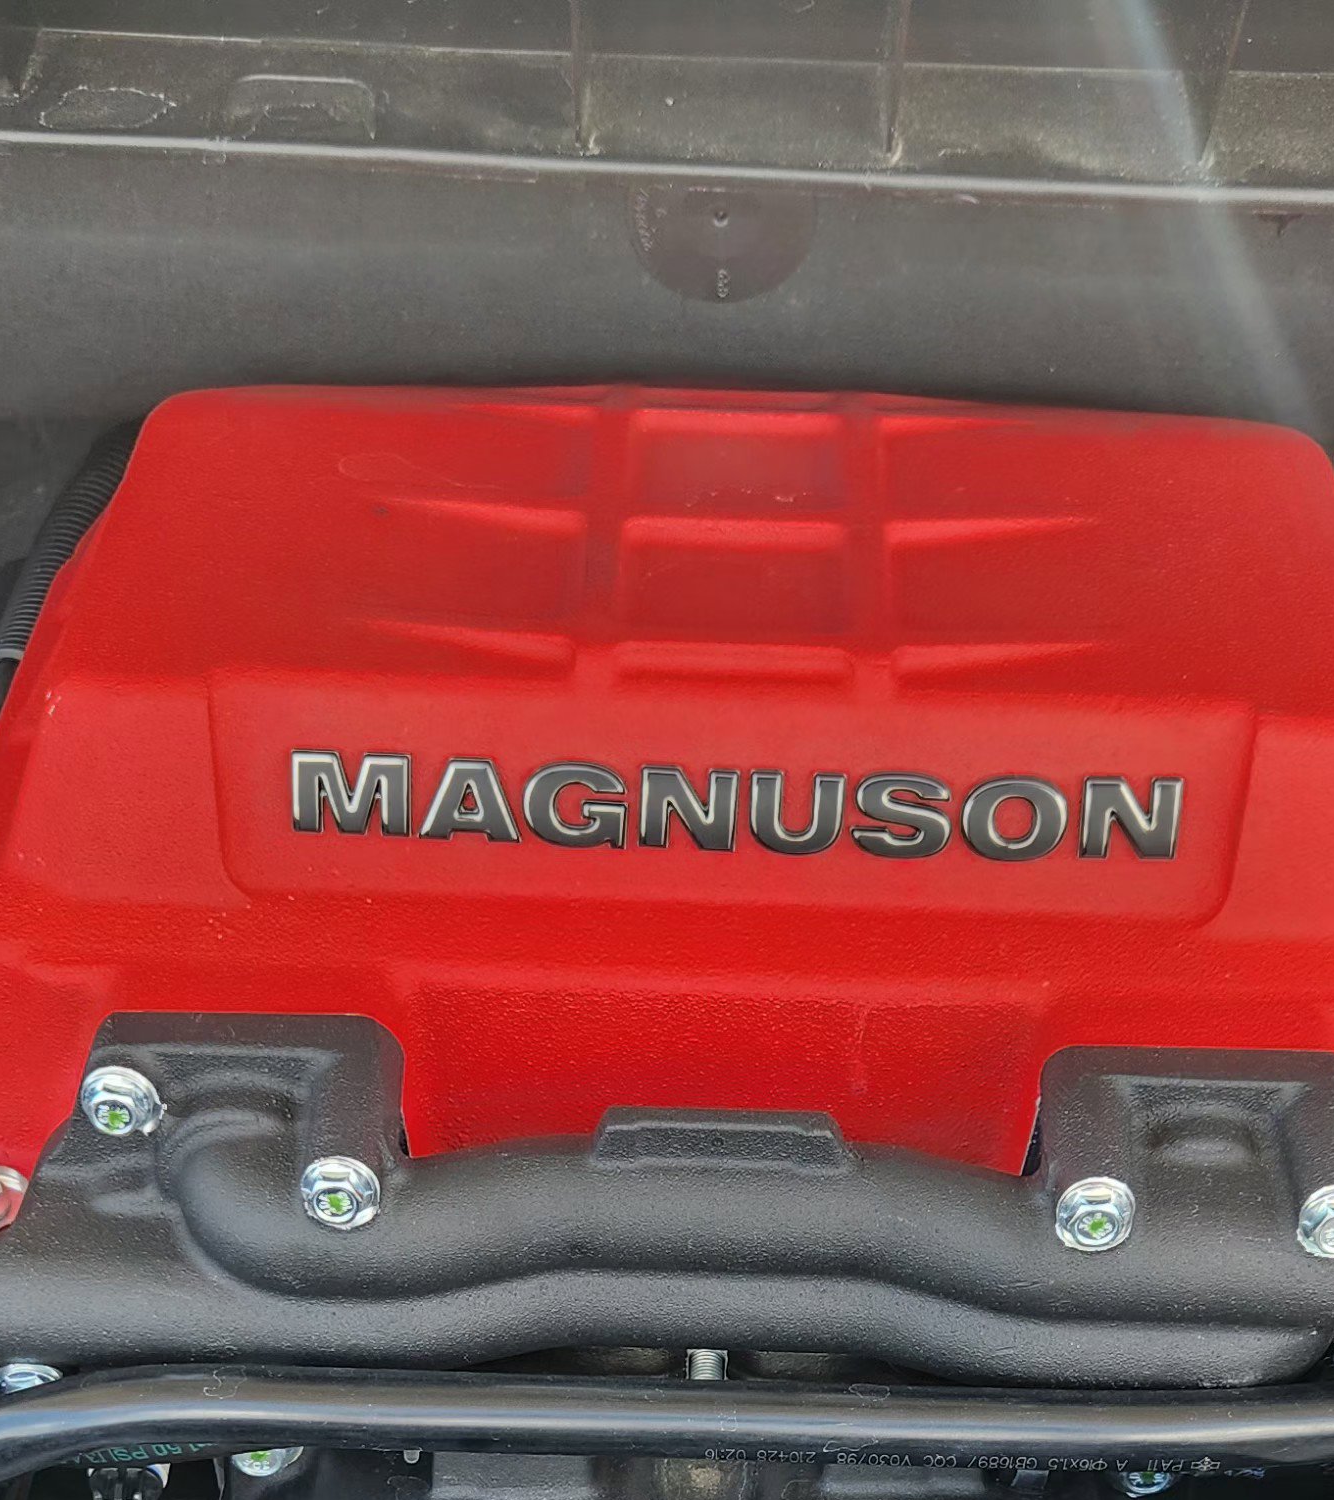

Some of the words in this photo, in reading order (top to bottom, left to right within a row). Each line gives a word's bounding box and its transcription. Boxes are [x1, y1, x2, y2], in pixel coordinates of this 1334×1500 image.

[291, 748, 1186, 861] MAGNUSON
[756, 1449, 817, 1464] 210428
[922, 1453, 957, 1468] CQC
